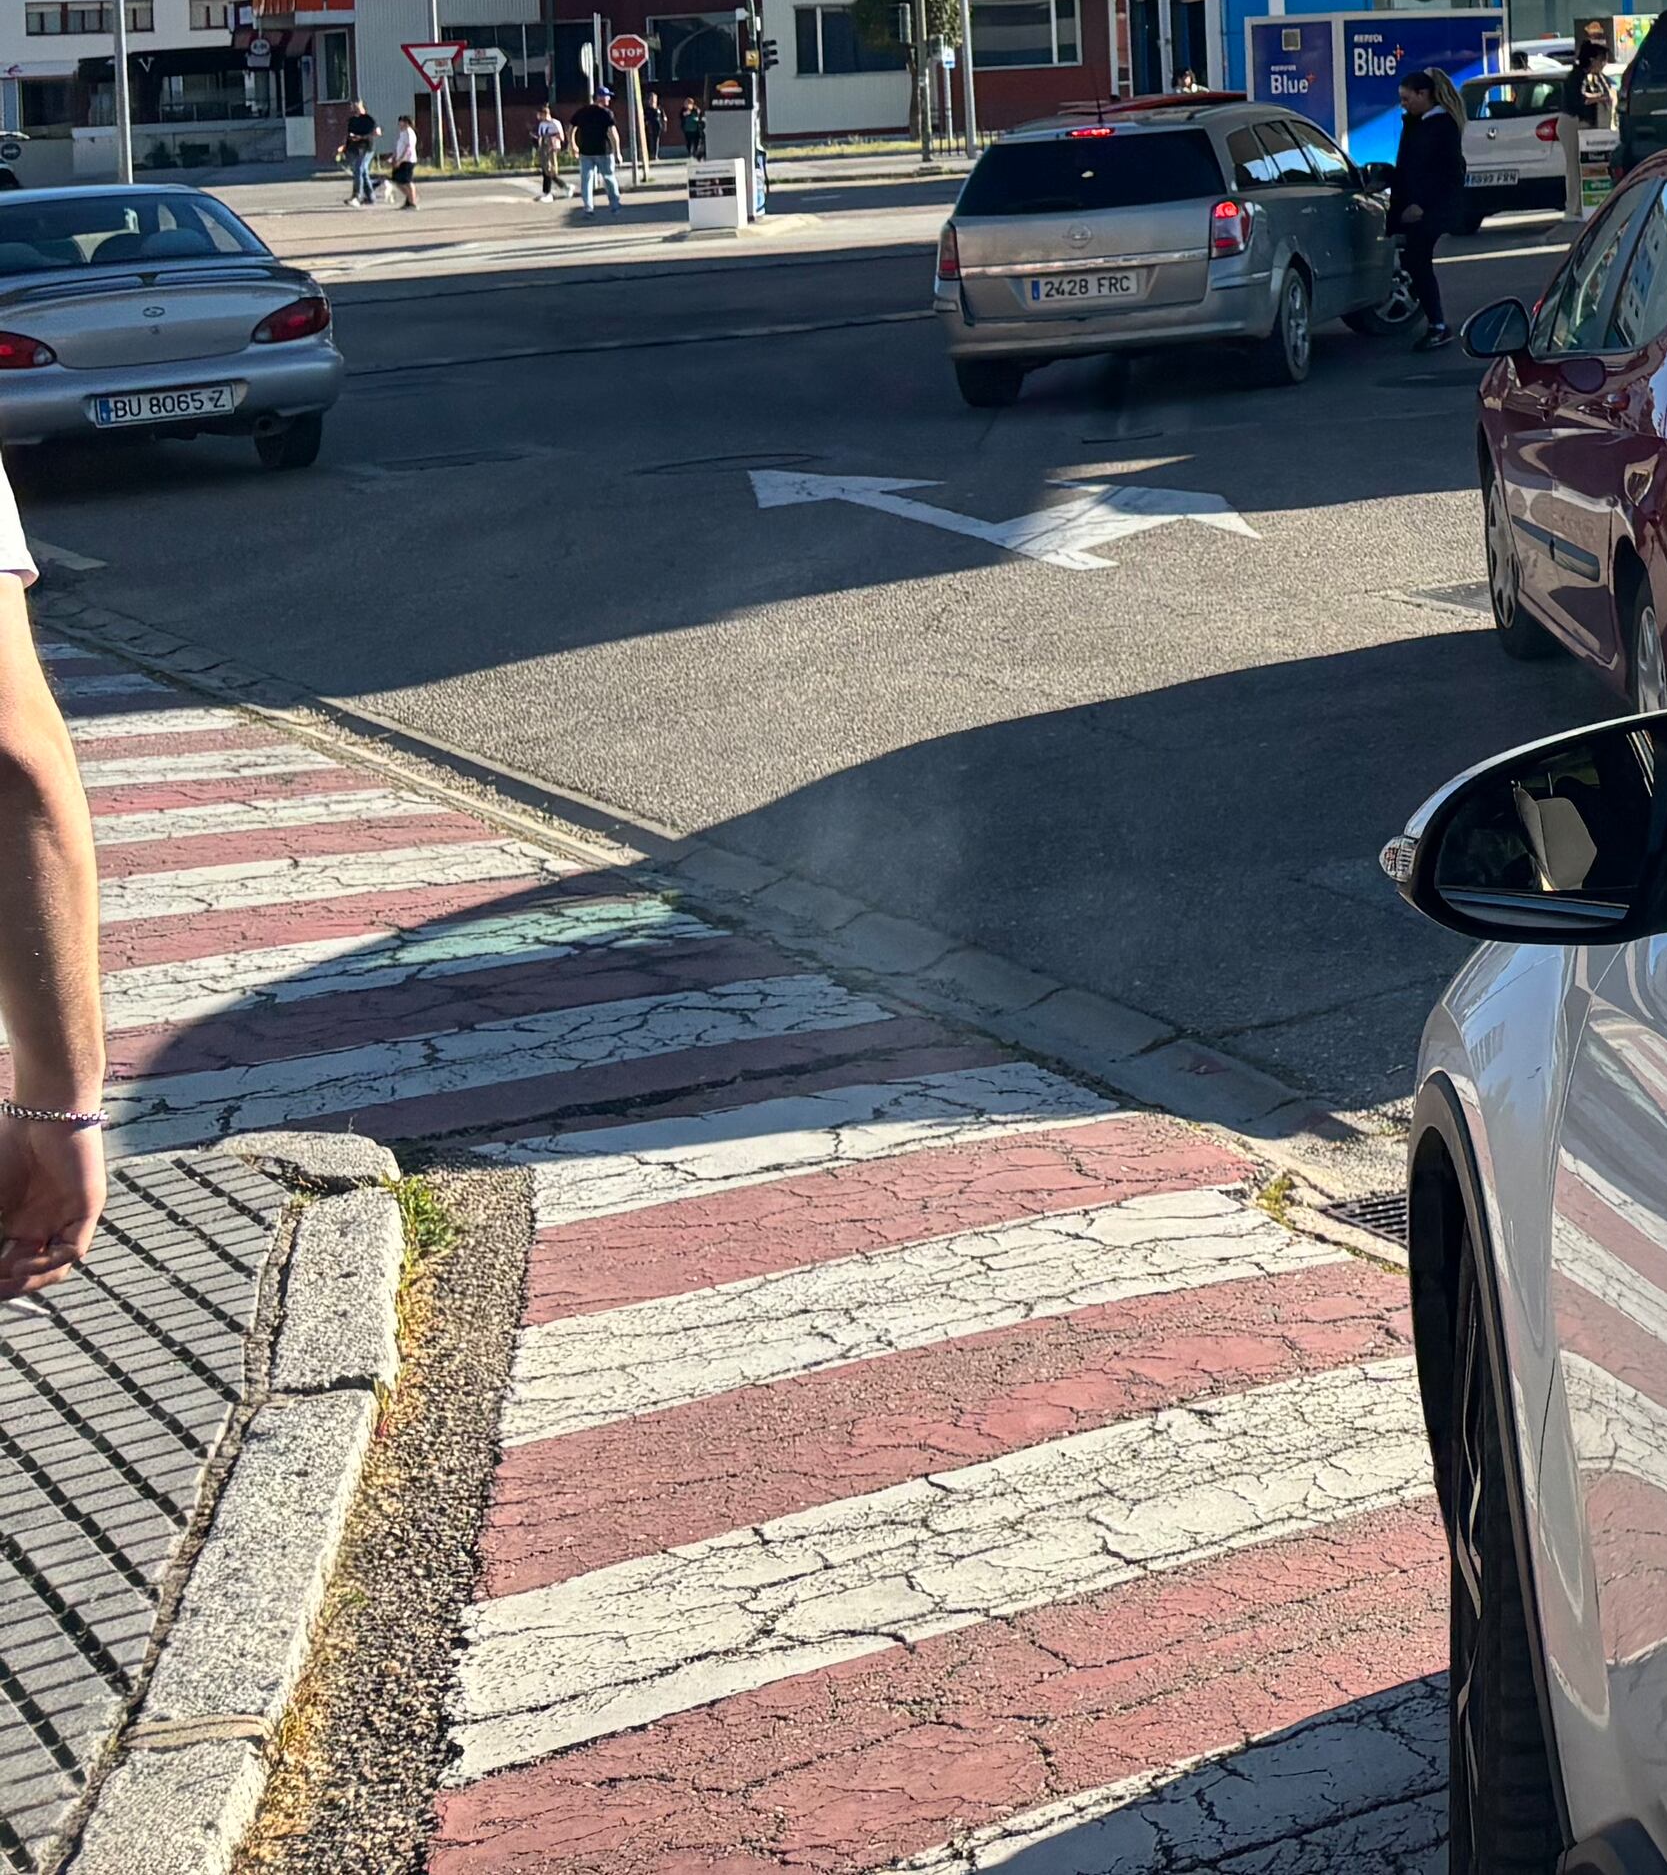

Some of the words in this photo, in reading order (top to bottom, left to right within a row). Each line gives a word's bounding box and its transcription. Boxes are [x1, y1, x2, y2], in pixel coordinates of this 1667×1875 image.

[612, 47, 643, 58] STOP
[1044, 278, 1089, 298] 2428
[1097, 275, 1131, 294] FRC
[113, 396, 142, 419] BU
[149, 391, 205, 415] 8065
[213, 389, 226, 409] Z
